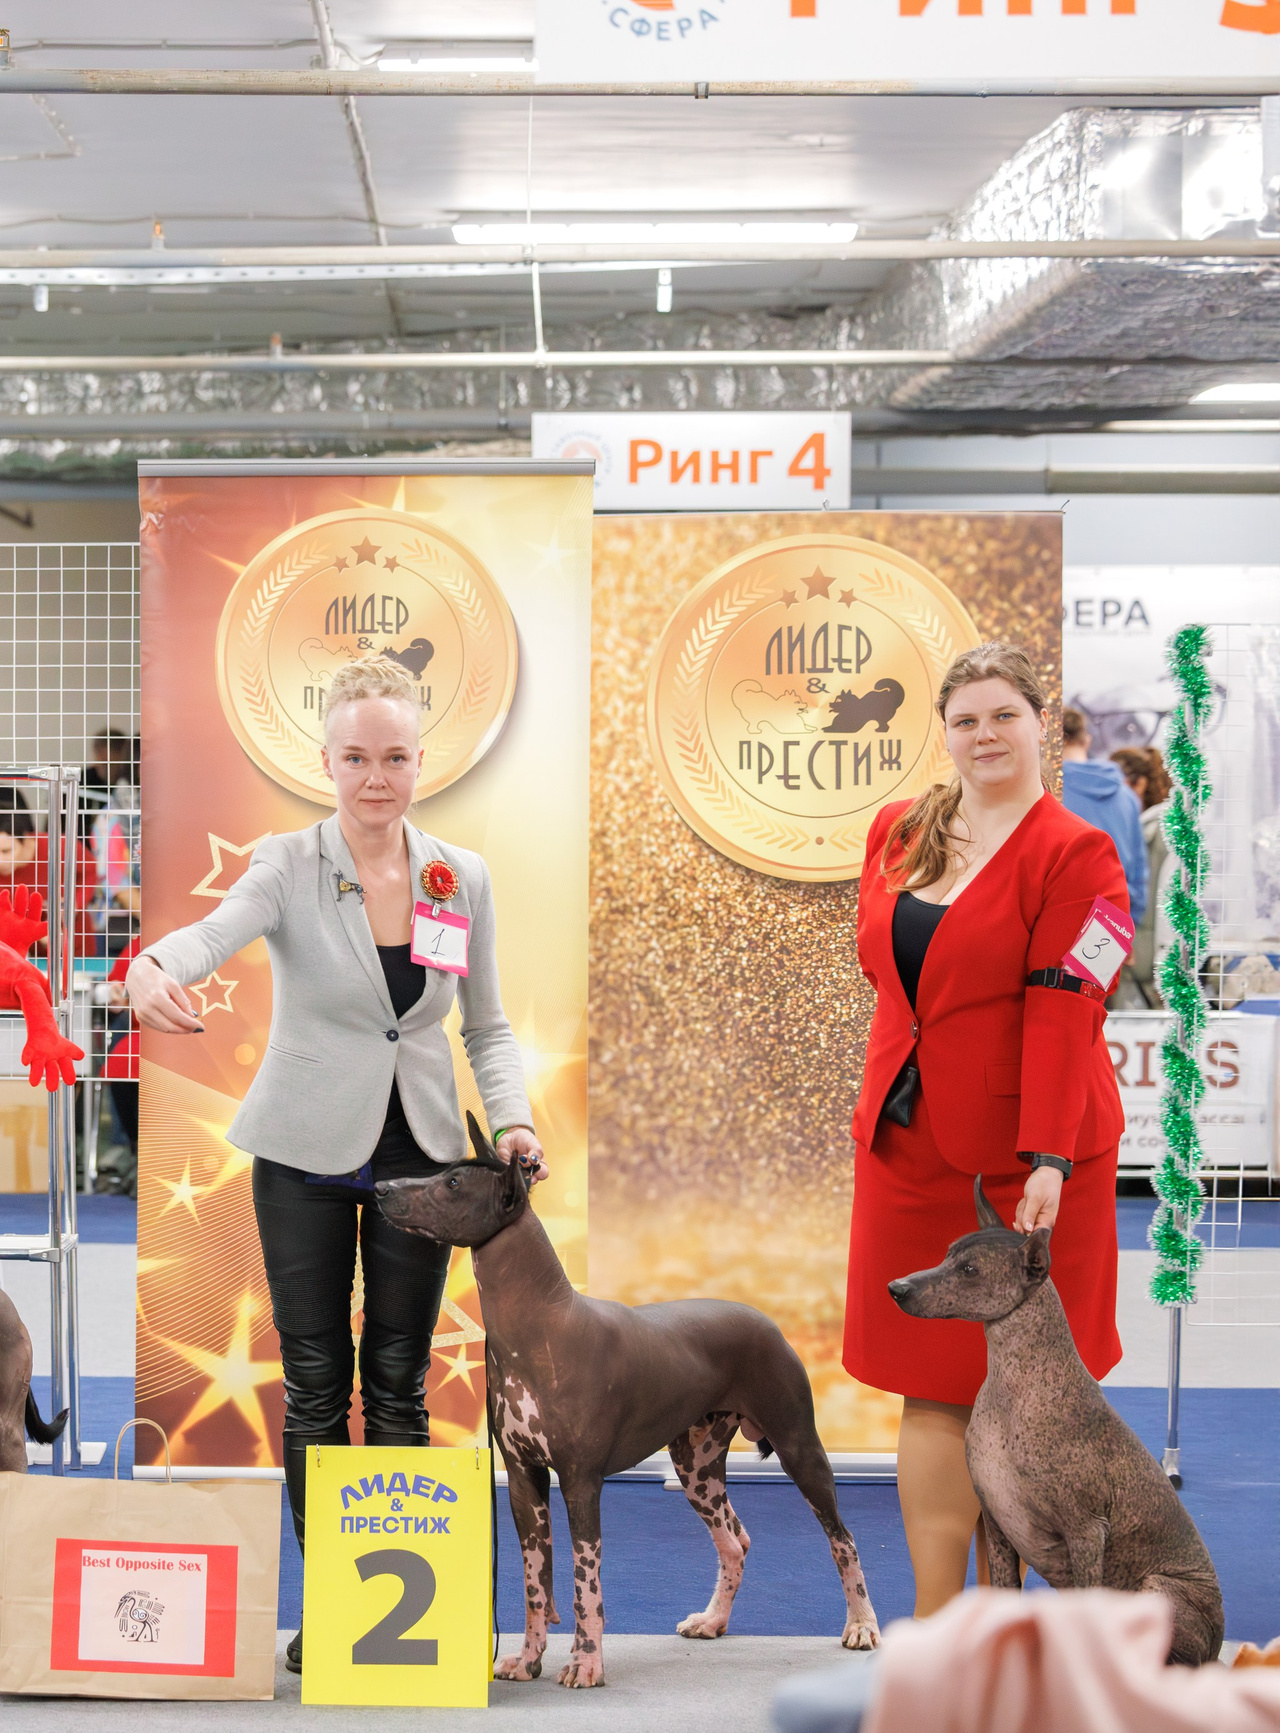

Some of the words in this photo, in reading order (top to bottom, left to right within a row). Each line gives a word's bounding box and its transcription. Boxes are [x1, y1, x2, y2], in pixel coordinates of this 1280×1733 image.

[609, 7, 719, 41] СФЕРА
[628, 439, 773, 484] Ринг
[787, 433, 832, 490] 4
[324, 592, 410, 636] ЛИДЕР
[1063, 599, 1150, 627] ЕРА
[356, 636, 376, 650] &
[765, 621, 873, 676] ЛИДЕР
[806, 677, 831, 694] &
[738, 738, 902, 791] ПРЕСТИЖ
[430, 928, 446, 956] 1
[1081, 937, 1110, 960] 3
[340, 1472, 459, 1510] ЛИДЕР
[390, 1498, 404, 1512] &
[340, 1516, 451, 1534] ПРЕСТИЖ
[82, 1555, 111, 1568] Best
[115, 1557, 174, 1572] Opposite
[178, 1559, 202, 1572] Sex
[352, 1548, 439, 1666] 2
